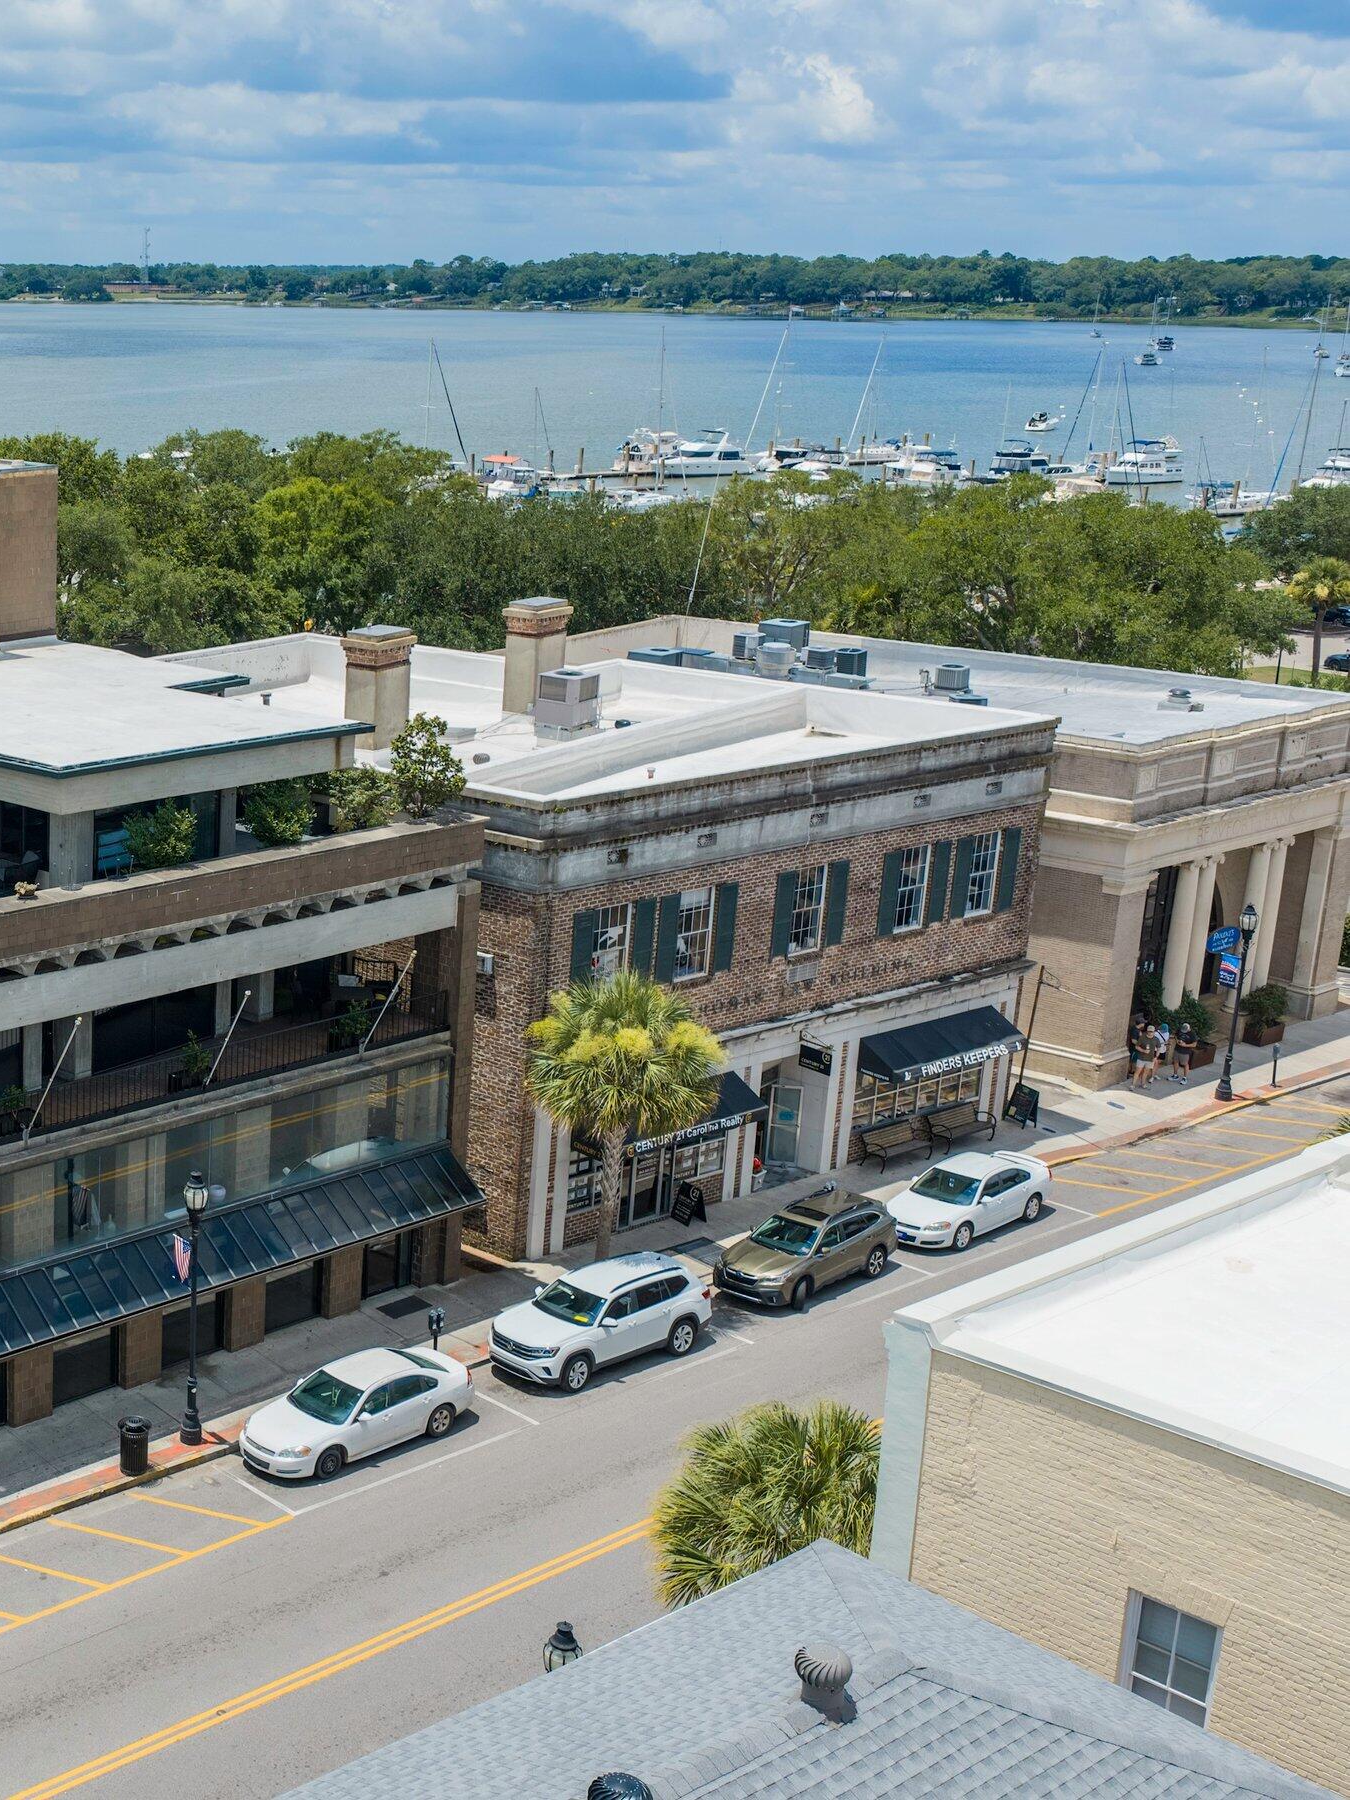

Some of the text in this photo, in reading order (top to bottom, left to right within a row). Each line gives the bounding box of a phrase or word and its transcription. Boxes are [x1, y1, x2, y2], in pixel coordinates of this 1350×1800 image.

[921, 1044, 1009, 1077] FINDERS KEEPERS
[635, 1133, 674, 1153] CENTURY
[676, 1131, 685, 1141] 21
[720, 1115, 744, 1129] Realty
